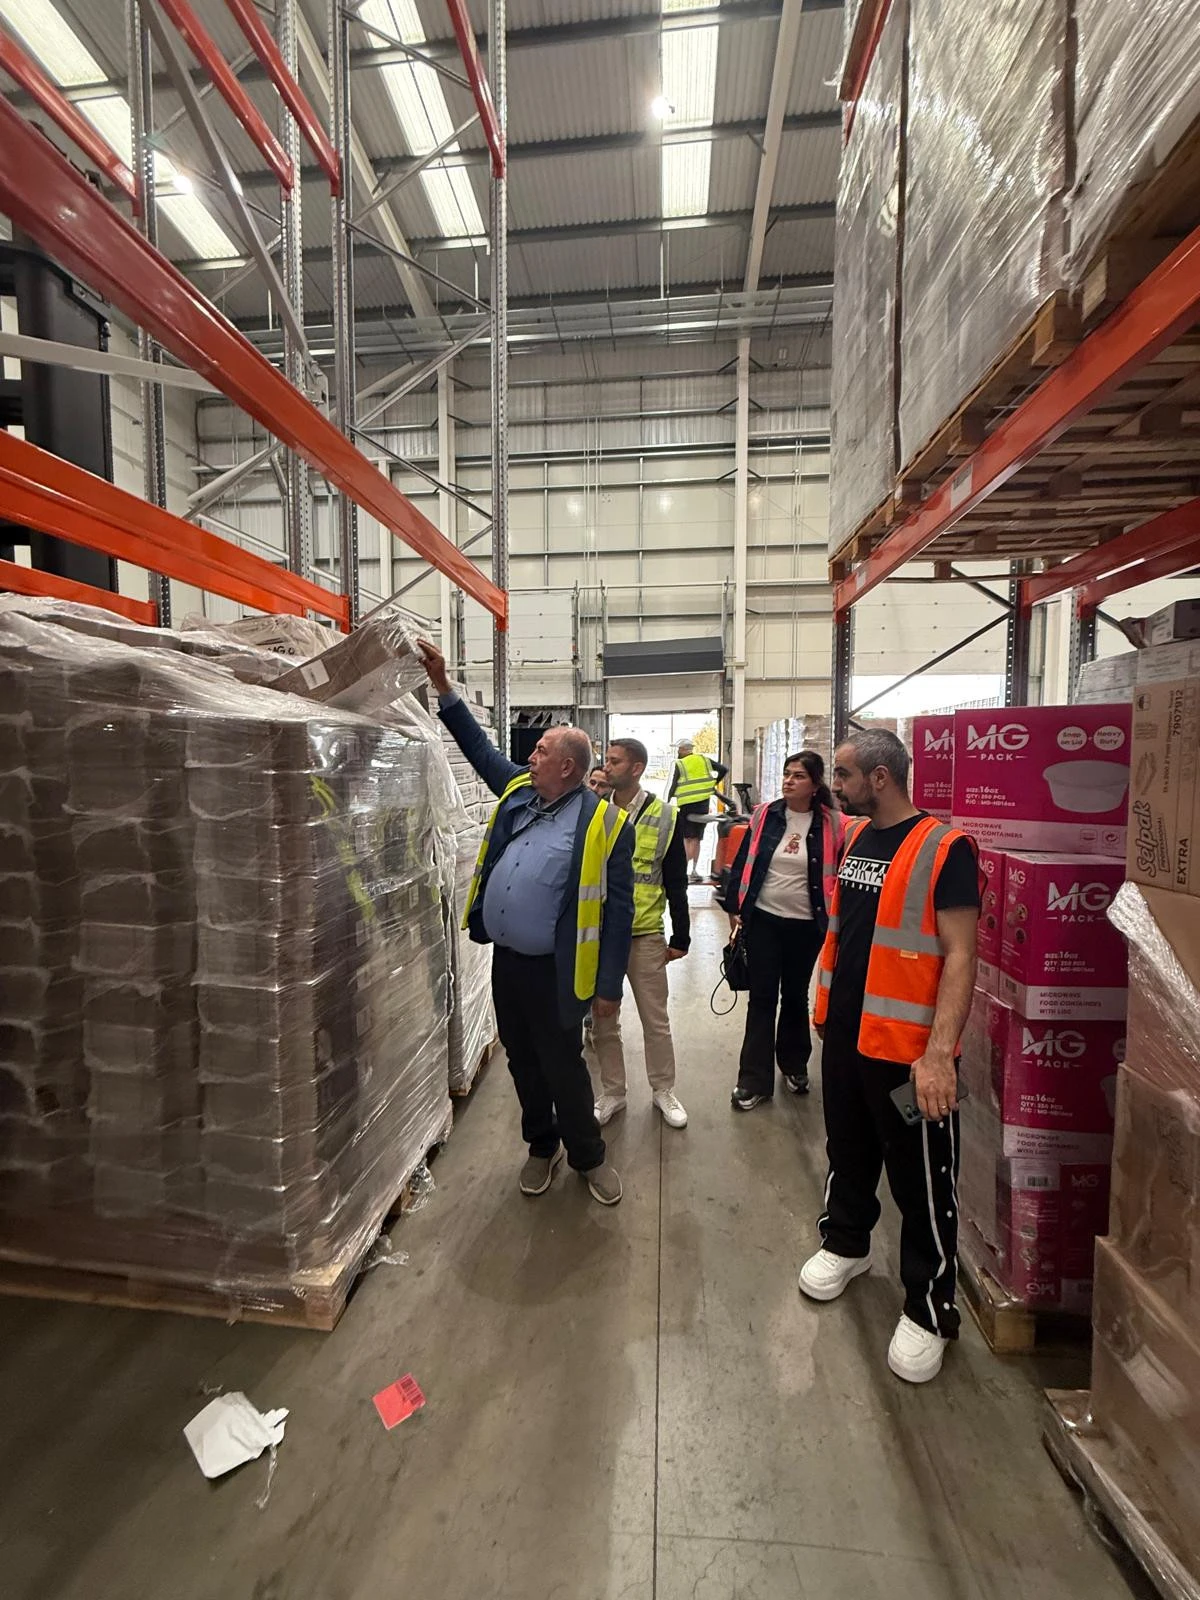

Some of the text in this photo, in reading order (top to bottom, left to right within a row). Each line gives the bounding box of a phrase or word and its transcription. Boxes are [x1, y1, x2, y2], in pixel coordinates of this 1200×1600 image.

[924, 729, 954, 751] M
[966, 723, 1030, 750] MG
[1097, 730, 1122, 738] Heavy
[981, 753, 1013, 761] PACK
[962, 821, 1002, 829] MICROWAVE
[981, 830, 1023, 838] CONTAINERS
[1132, 800, 1156, 877] Selpak
[979, 858, 995, 874] MG
[1177, 838, 1188, 884] EXTRA
[839, 858, 886, 885] ESIKTA
[1008, 866, 1026, 885] MG
[1046, 882, 1111, 911] MG
[1061, 914, 1095, 922] PACK
[1021, 1027, 1087, 1058] MG
[1036, 1059, 1070, 1068] PACK
[1017, 1132, 1060, 1140] MICROWAVE
